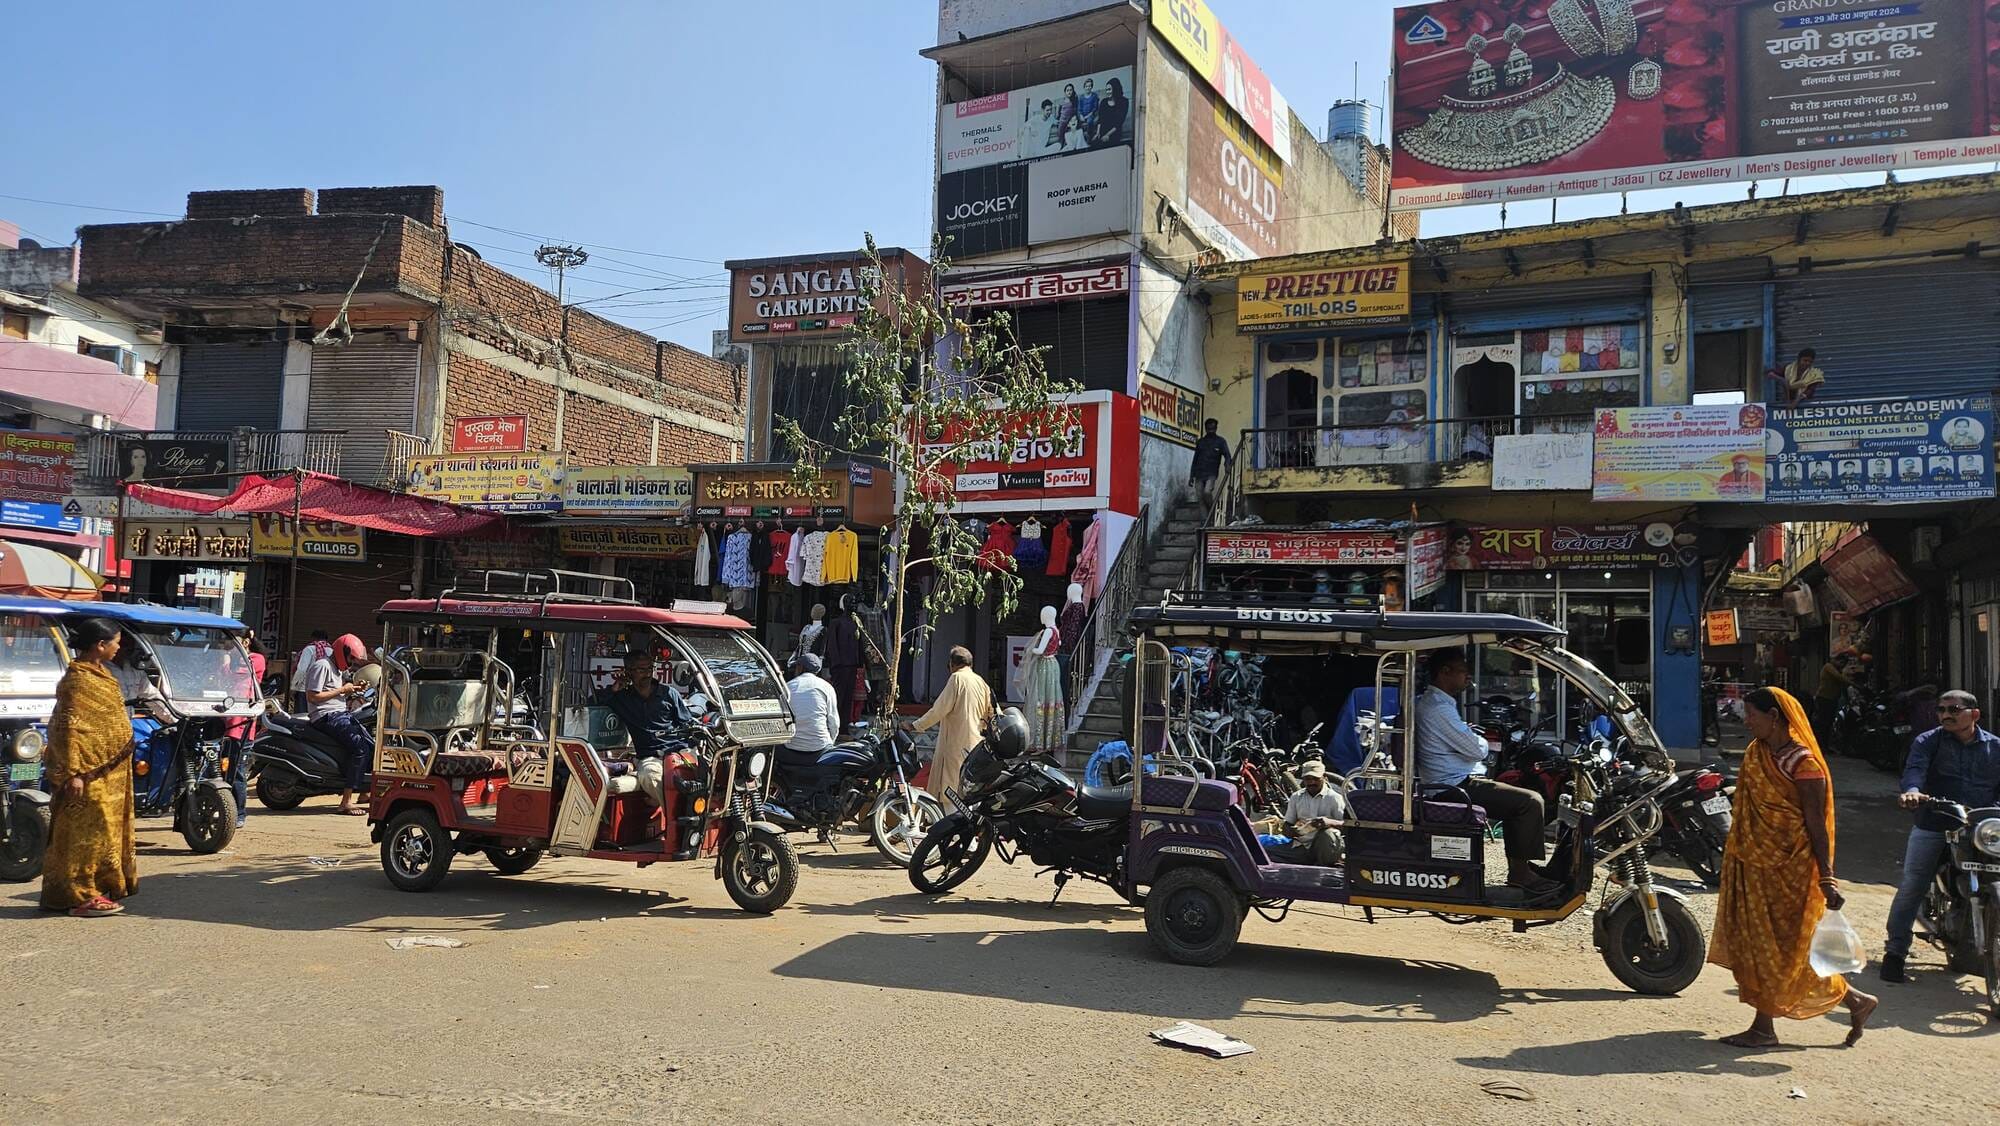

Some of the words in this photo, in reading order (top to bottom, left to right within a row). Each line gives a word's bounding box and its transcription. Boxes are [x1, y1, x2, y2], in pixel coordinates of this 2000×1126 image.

[1880, 8, 1900, 16] 2024
[1766, 29, 1822, 54] रानी
[1828, 22, 1938, 48] अलंकार
[1780, 49, 1847, 69] ज्वेलर्स
[1852, 50, 1882, 64] प्रा.
[1888, 43, 1923, 59] लि.
[1806, 100, 1820, 110] रोड
[1822, 98, 1852, 108] अनपरा
[1822, 112, 1840, 120] Toll
[1843, 109, 1866, 118] Free
[1875, 107, 1900, 116] 1800
[962, 124, 1002, 138] THERMALS
[974, 136, 990, 145] FOR
[1913, 147, 1956, 160] Temple
[1746, 162, 1780, 174] Men's
[1784, 157, 1836, 174] Designer
[1839, 153, 1898, 169] Jewellery
[1612, 173, 1645, 186] Jadau
[1658, 170, 1674, 182] CZ
[1676, 166, 1731, 181] Jewellery
[1047, 188, 1071, 199] ROOP
[1072, 182, 1108, 194] VARSHA
[1221, 141, 1276, 224] GOLD
[1506, 183, 1545, 196] Kundan
[1558, 178, 1598, 192] Antique
[1058, 195, 1096, 208] HOSIERY
[1398, 193, 1442, 205] Diamond
[1444, 187, 1494, 202] Jewellery
[946, 194, 1018, 220] JOCKEY
[1219, 188, 1277, 250] INNERWEAR
[750, 266, 882, 298] SANGAM
[1242, 290, 1260, 302] NEW
[1262, 266, 1398, 300] PRESTIGE
[756, 296, 870, 318] GARMENTS
[1283, 300, 1358, 317] TAILORS
[1773, 404, 1874, 420] MILESTONE
[1879, 399, 1968, 414] ACADEMY
[464, 420, 496, 438] पुस्तक
[498, 417, 516, 433] मेला
[1786, 418, 1840, 428] COACHING
[1844, 414, 1899, 425] INSTITUTE
[1829, 428, 1864, 437] BOARD
[1868, 426, 1900, 434] CLASS
[1876, 450, 1900, 458] Open
[1918, 444, 1950, 455] 95%
[158, 446, 206, 474] Riya
[480, 455, 518, 472] स्टेशनरी
[577, 474, 621, 496] बालाजी
[624, 474, 671, 496] मेडिकल
[968, 478, 996, 486] JOCKEY
[1046, 471, 1088, 486] Sparky
[128, 527, 149, 556] माँ
[154, 527, 200, 557] अंजनी
[304, 541, 357, 555] TAILORS
[1348, 536, 1386, 548] स्टोर
[1480, 529, 1544, 554] राज
[1237, 609, 1272, 622] BIG
[1279, 610, 1334, 624] BOSS
[1372, 870, 1401, 888] BIG
[1405, 872, 1446, 889] BOSS
